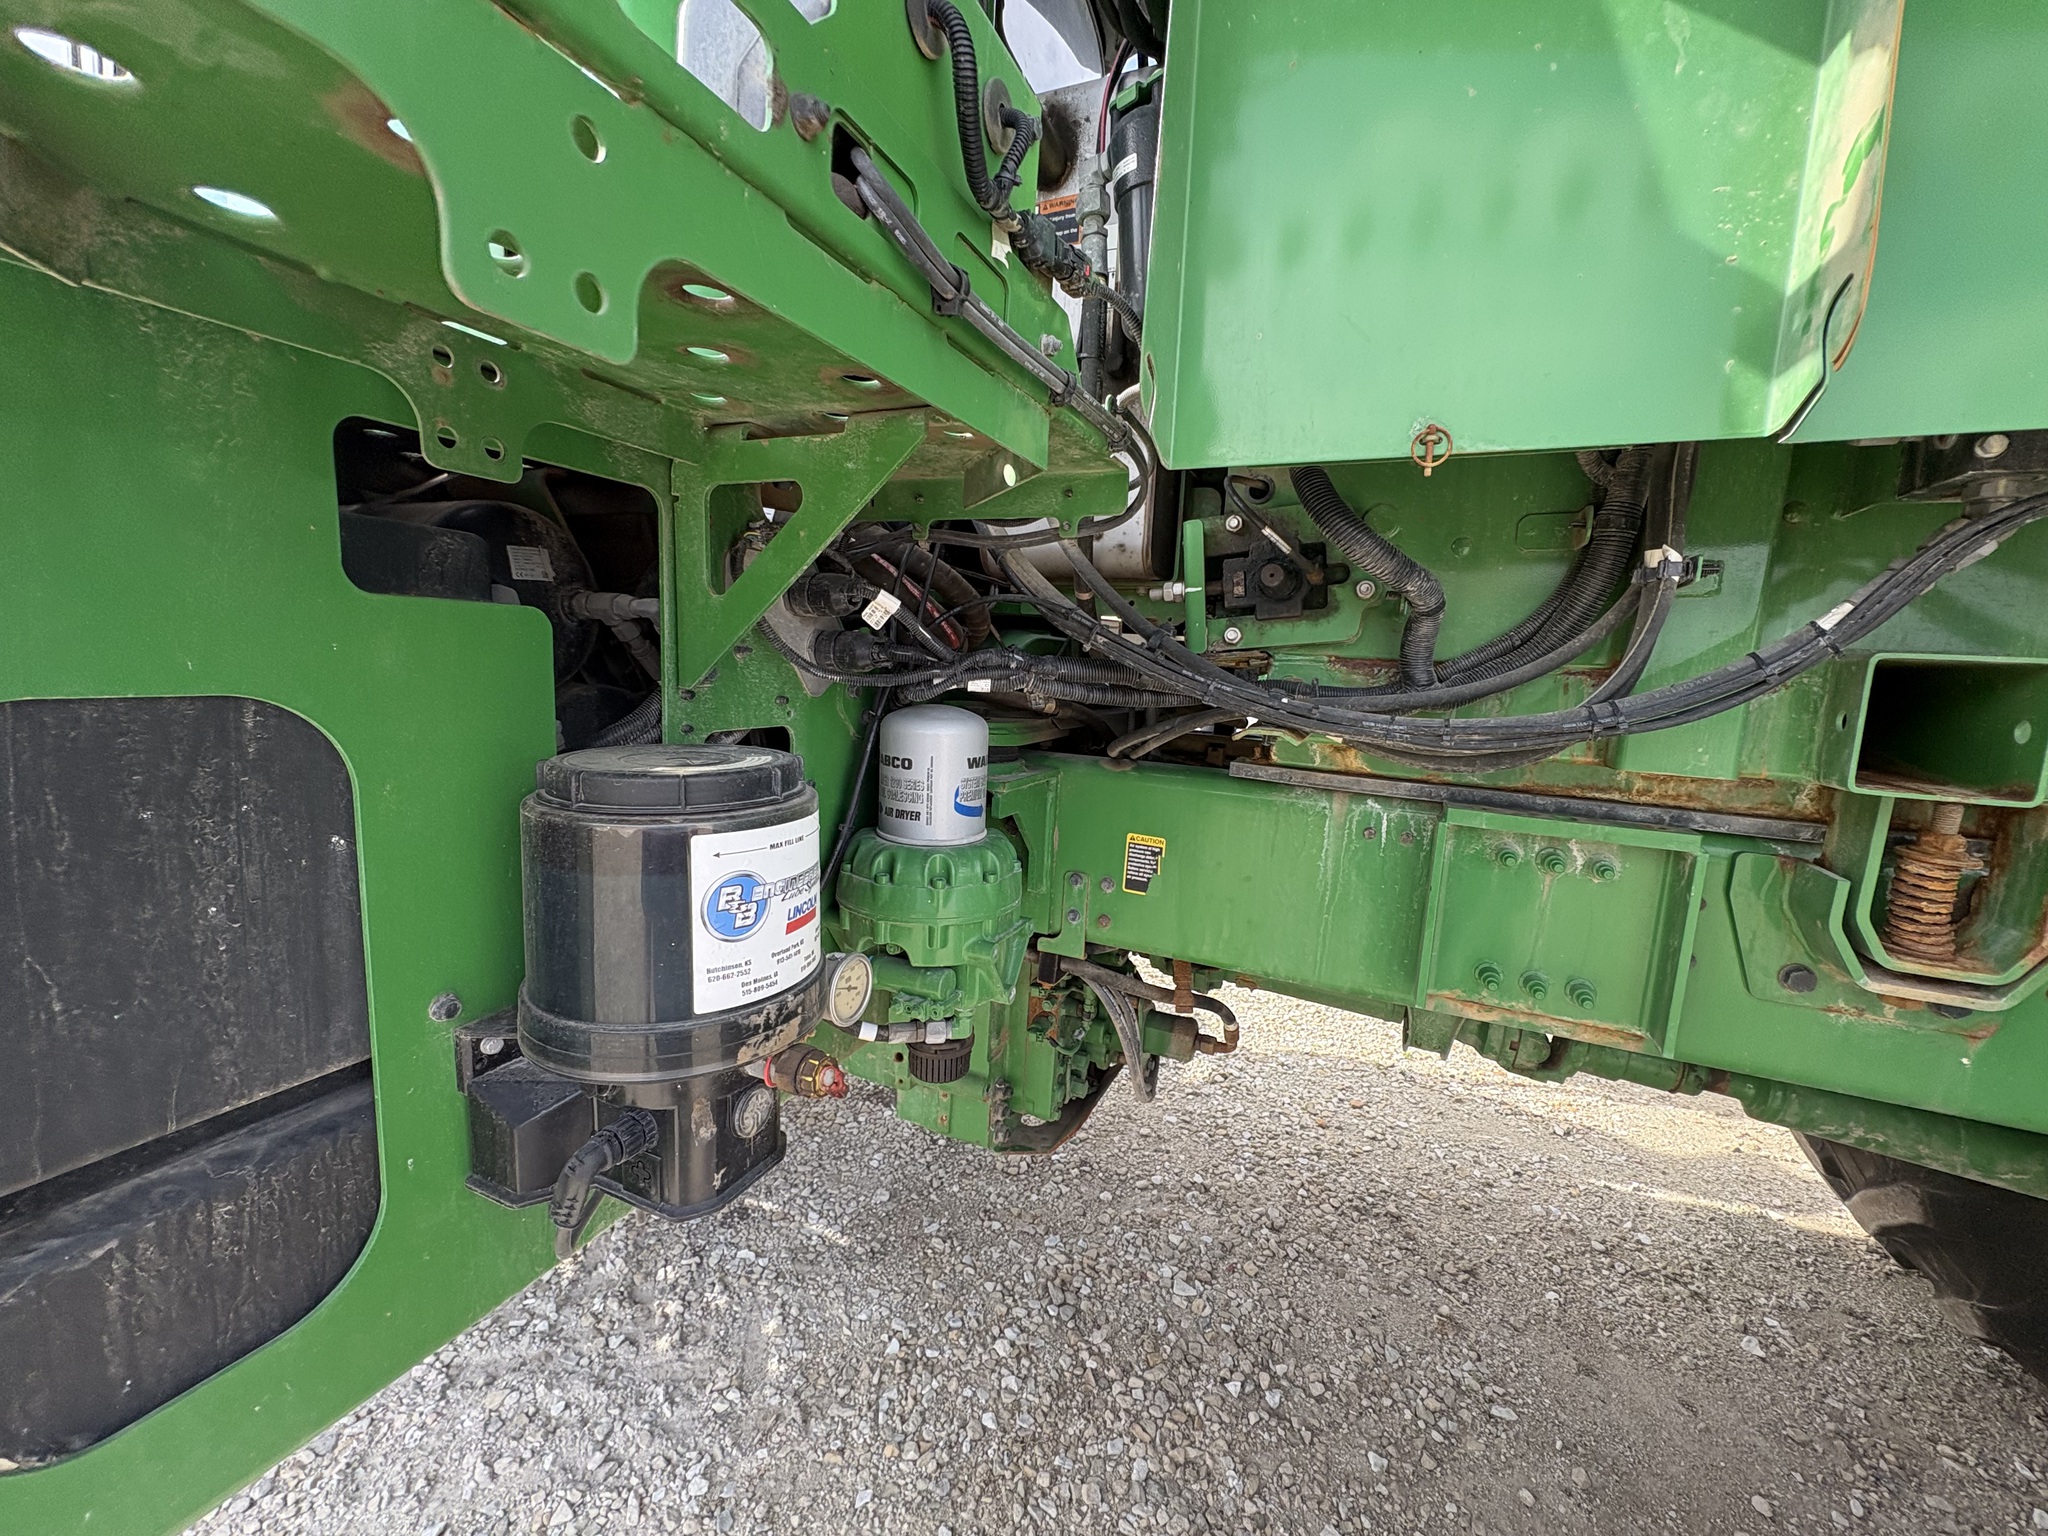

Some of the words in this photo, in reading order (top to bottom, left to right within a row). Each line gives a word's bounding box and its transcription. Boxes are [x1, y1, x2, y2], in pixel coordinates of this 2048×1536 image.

[880, 753, 913, 770] ABCO
[884, 806, 894, 818] AIR
[895, 808, 921, 821] DRYER
[769, 841, 784, 851] MAX
[784, 837, 795, 847] FILL
[1135, 835, 1164, 846] CAUTION
[787, 892, 817, 921] LINCOLN
[744, 959, 752, 967] KS
[707, 967, 751, 983] 620-662-2552
[741, 980, 752, 988] Des
